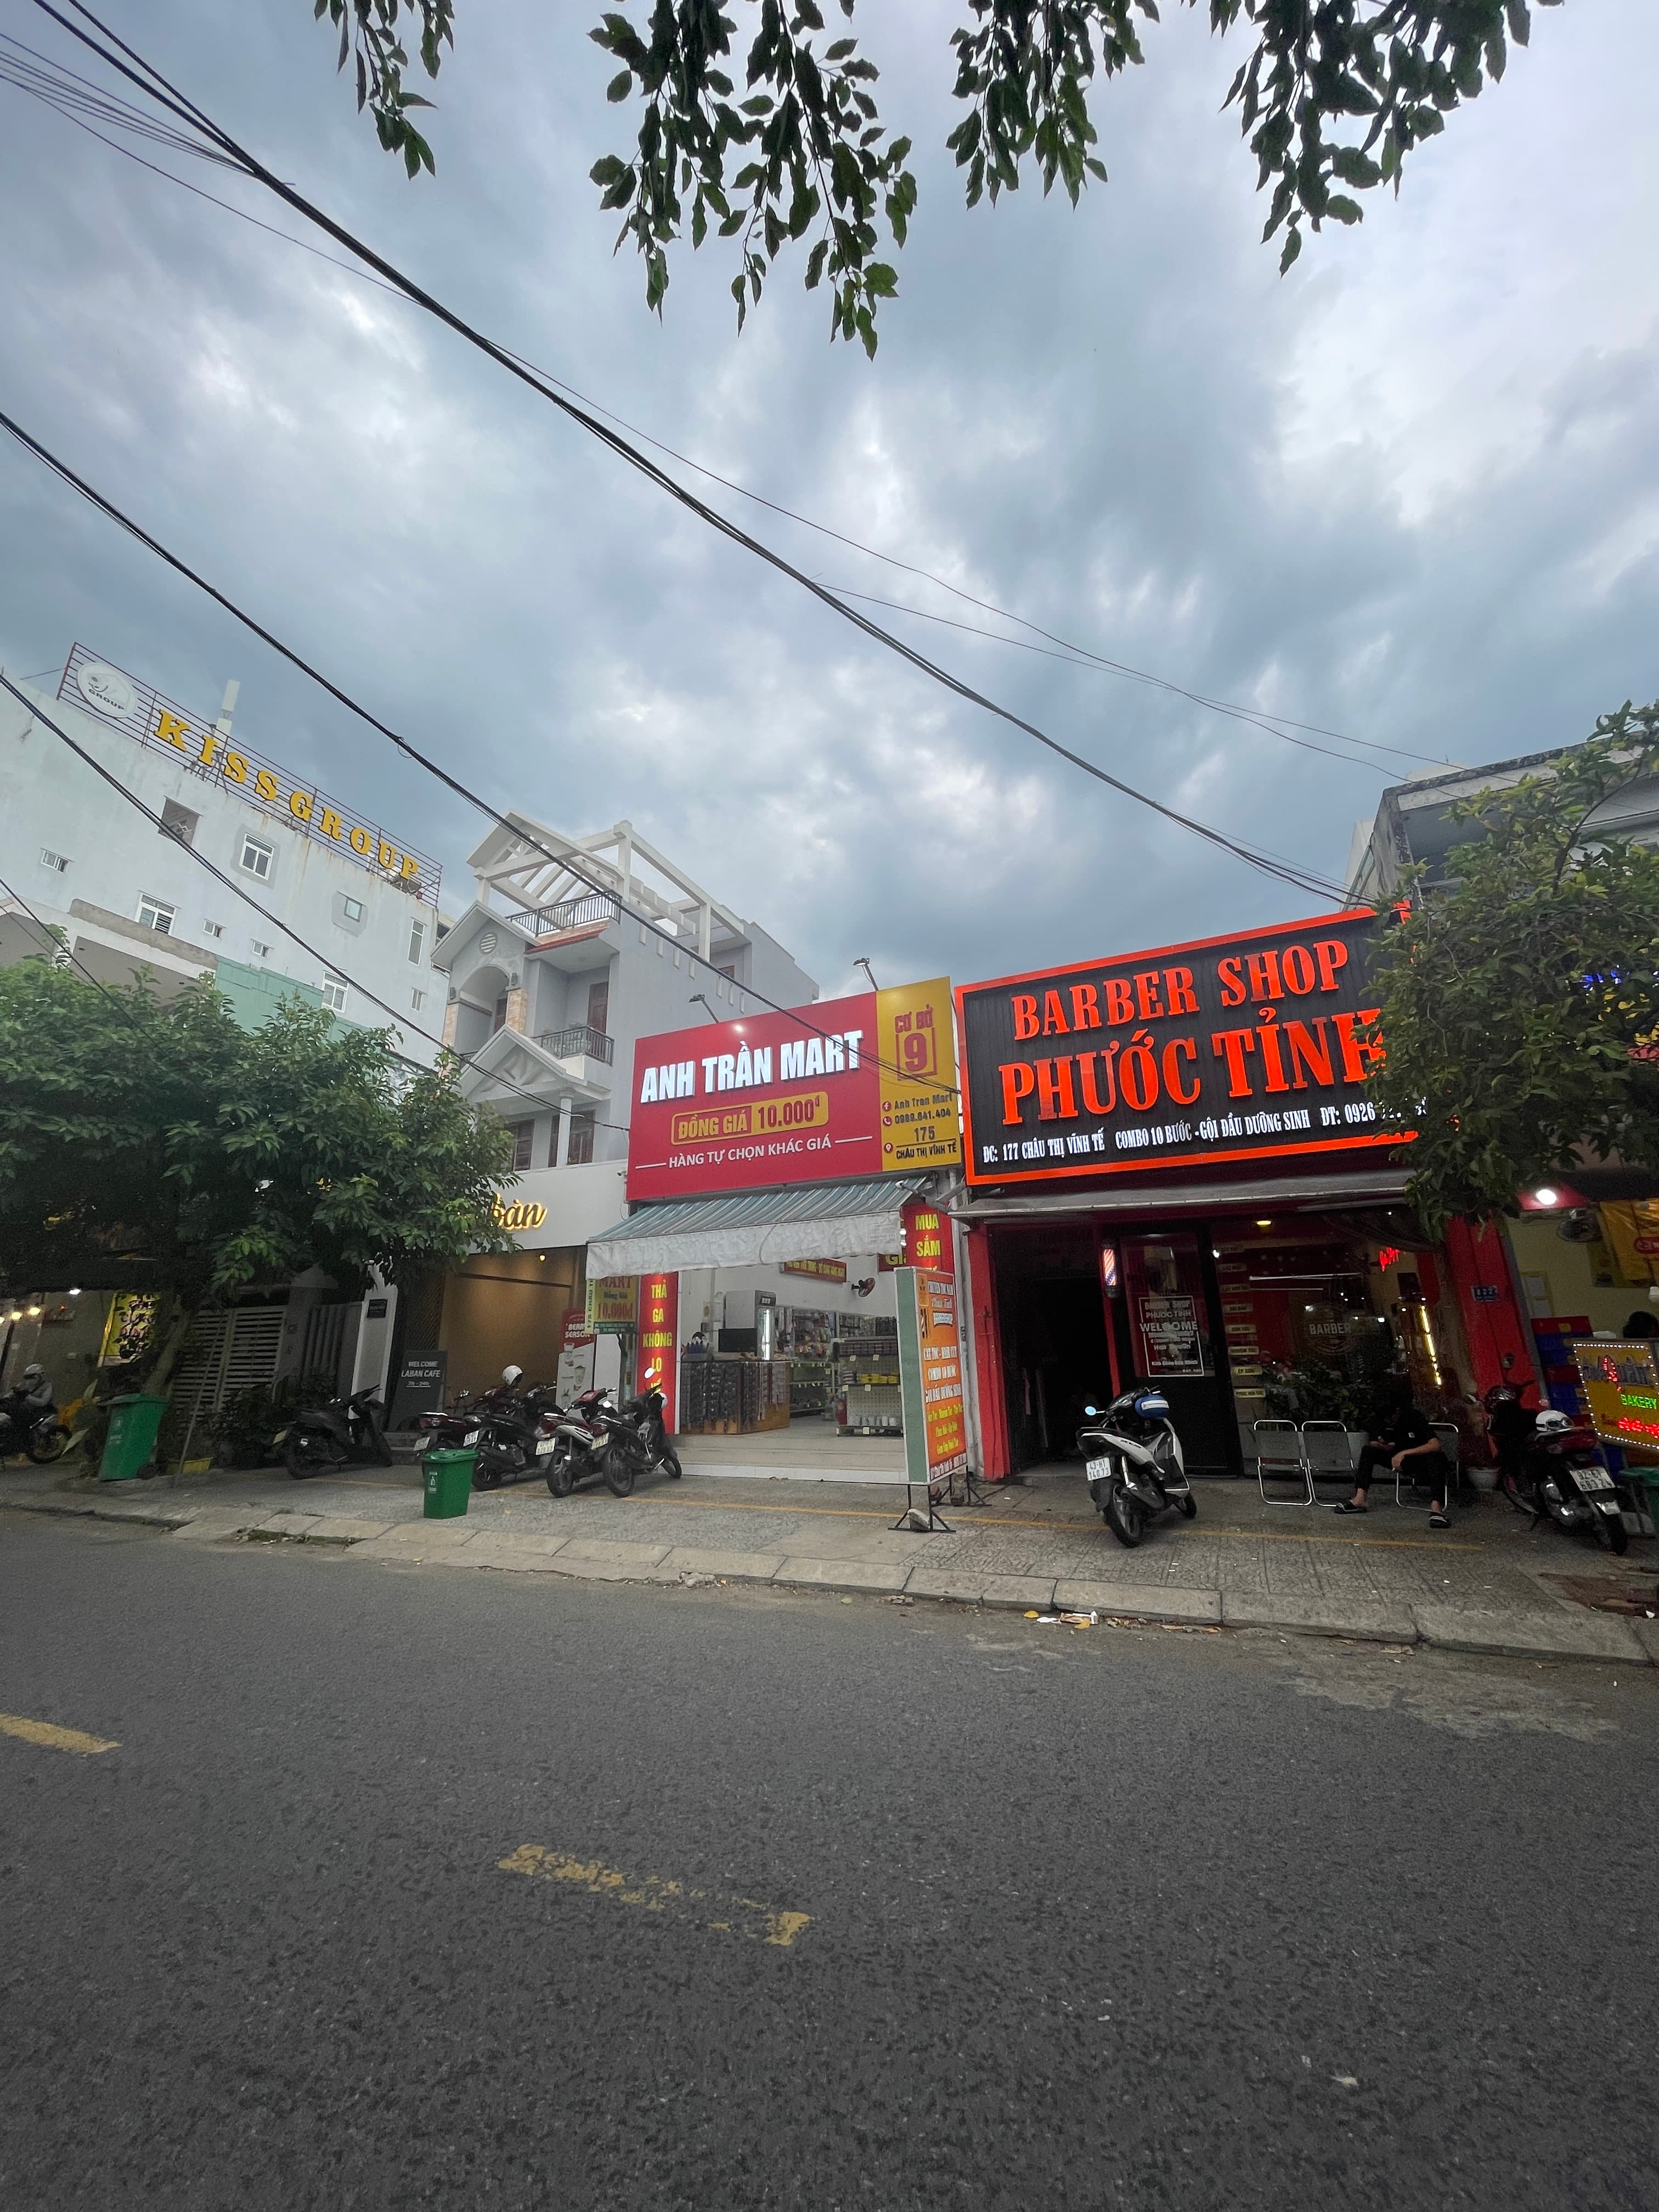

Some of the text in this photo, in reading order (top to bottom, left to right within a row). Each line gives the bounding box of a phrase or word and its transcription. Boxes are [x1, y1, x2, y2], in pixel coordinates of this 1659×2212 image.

[1011, 940, 1348, 1041] BARBER SHOP
[904, 1032, 928, 1072] 9
[640, 1030, 864, 1103] ANH TRẦN MART
[998, 1007, 1387, 1125] PHƯỚC TỈNH
[894, 1099, 910, 1110] Anh
[678, 1114, 719, 1139] ĐỒNG
[723, 1109, 748, 1134] GIÁ
[914, 1125, 935, 1142] 175
[1003, 1142, 1019, 1161] 177
[1022, 1137, 1045, 1159] CHÂU
[1047, 1137, 1065, 1158] THỊ
[1066, 1133, 1091, 1154] VĨNH
[1092, 1127, 1105, 1152] TẾ
[1115, 1128, 1149, 1150] COMBO
[1150, 1126, 1164, 1146] 10
[1165, 1119, 1192, 1144] BƯỚC
[1220, 1112, 1243, 1137] ĐẦU
[1245, 1111, 1282, 1135] DƯỠNG
[1284, 1109, 1311, 1131] SINH
[668, 1133, 832, 1169] HÀNG TỰ CHỌN KHÁC GIÁ
[915, 1214, 940, 1231] MUA
[916, 1234, 941, 1257] SẮM
[651, 1279, 668, 1299] THẢ
[652, 1307, 664, 1323] GA
[642, 1329, 673, 1348] KHÔNG
[400, 1369, 423, 1378] LABAN
